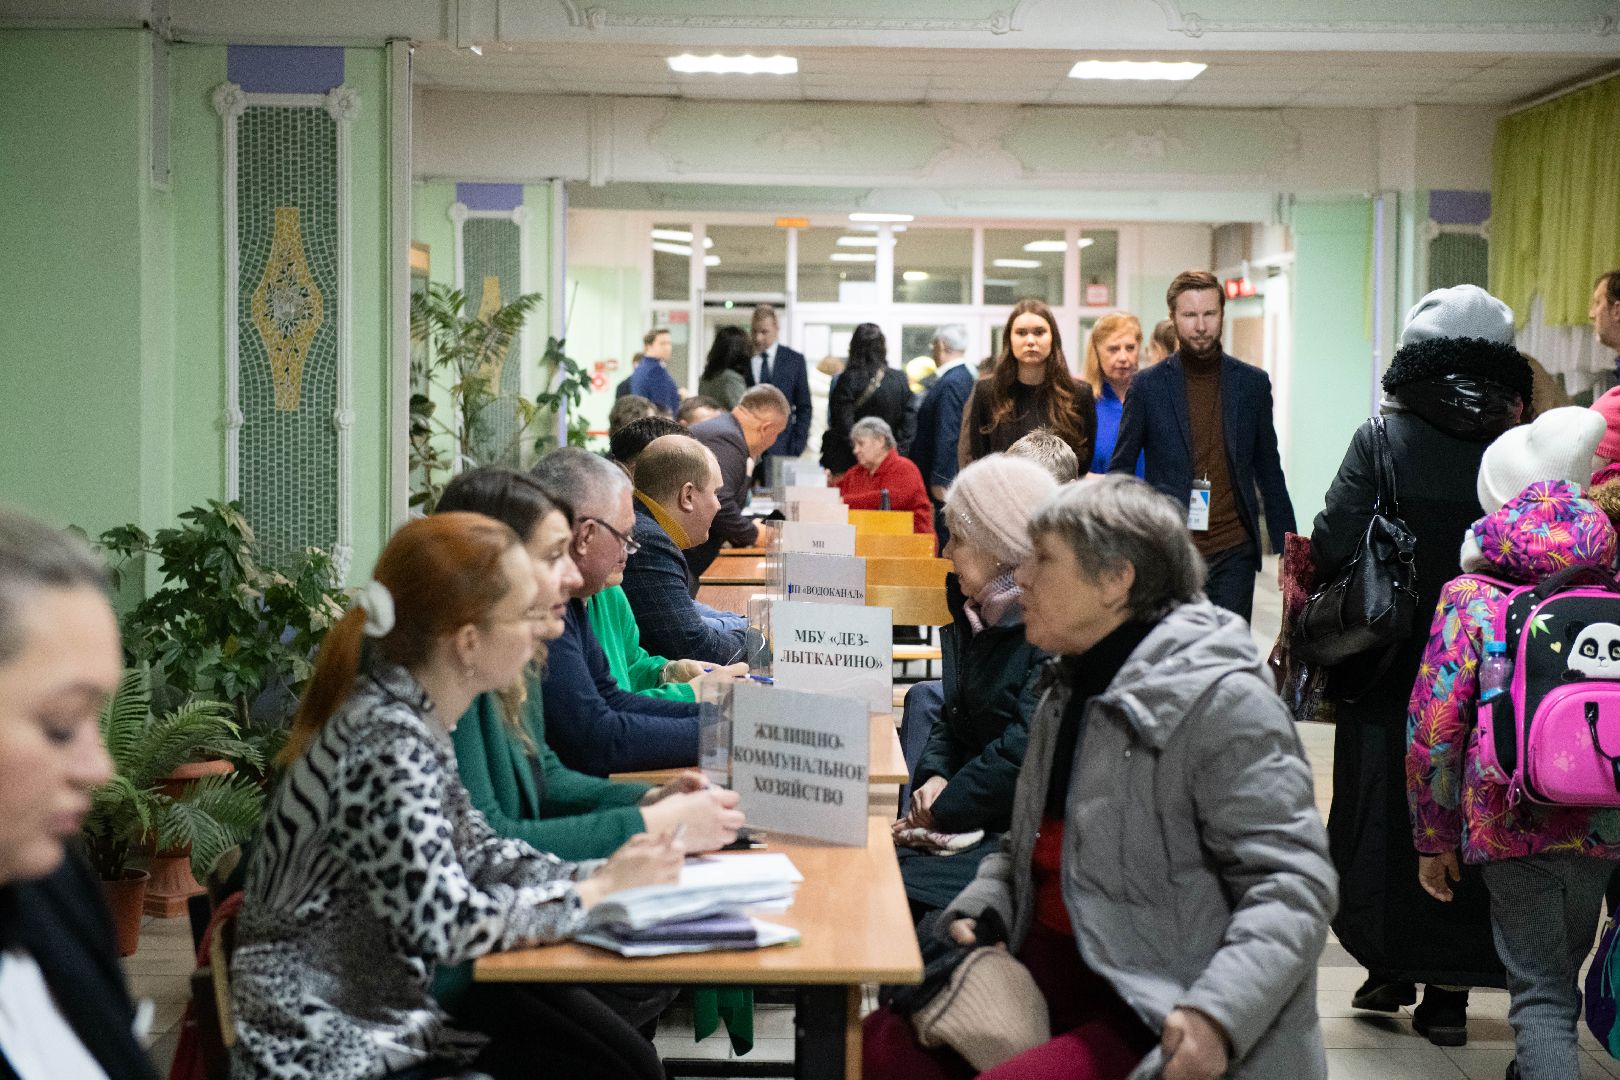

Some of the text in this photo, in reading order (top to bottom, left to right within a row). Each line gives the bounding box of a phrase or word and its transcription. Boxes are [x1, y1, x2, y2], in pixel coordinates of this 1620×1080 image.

[802, 586, 864, 599] «ВОДОКАНАЛ»
[795, 629, 869, 647] МБУ «ДЕЗ-
[780, 650, 883, 670] ЛЫТКАРИНО»
[754, 722, 845, 749] ЖИЛИЩНО-
[734, 745, 866, 782] КОММУНАЛЬНОЕ
[754, 776, 843, 806] ХОЗЯЙСТВО
